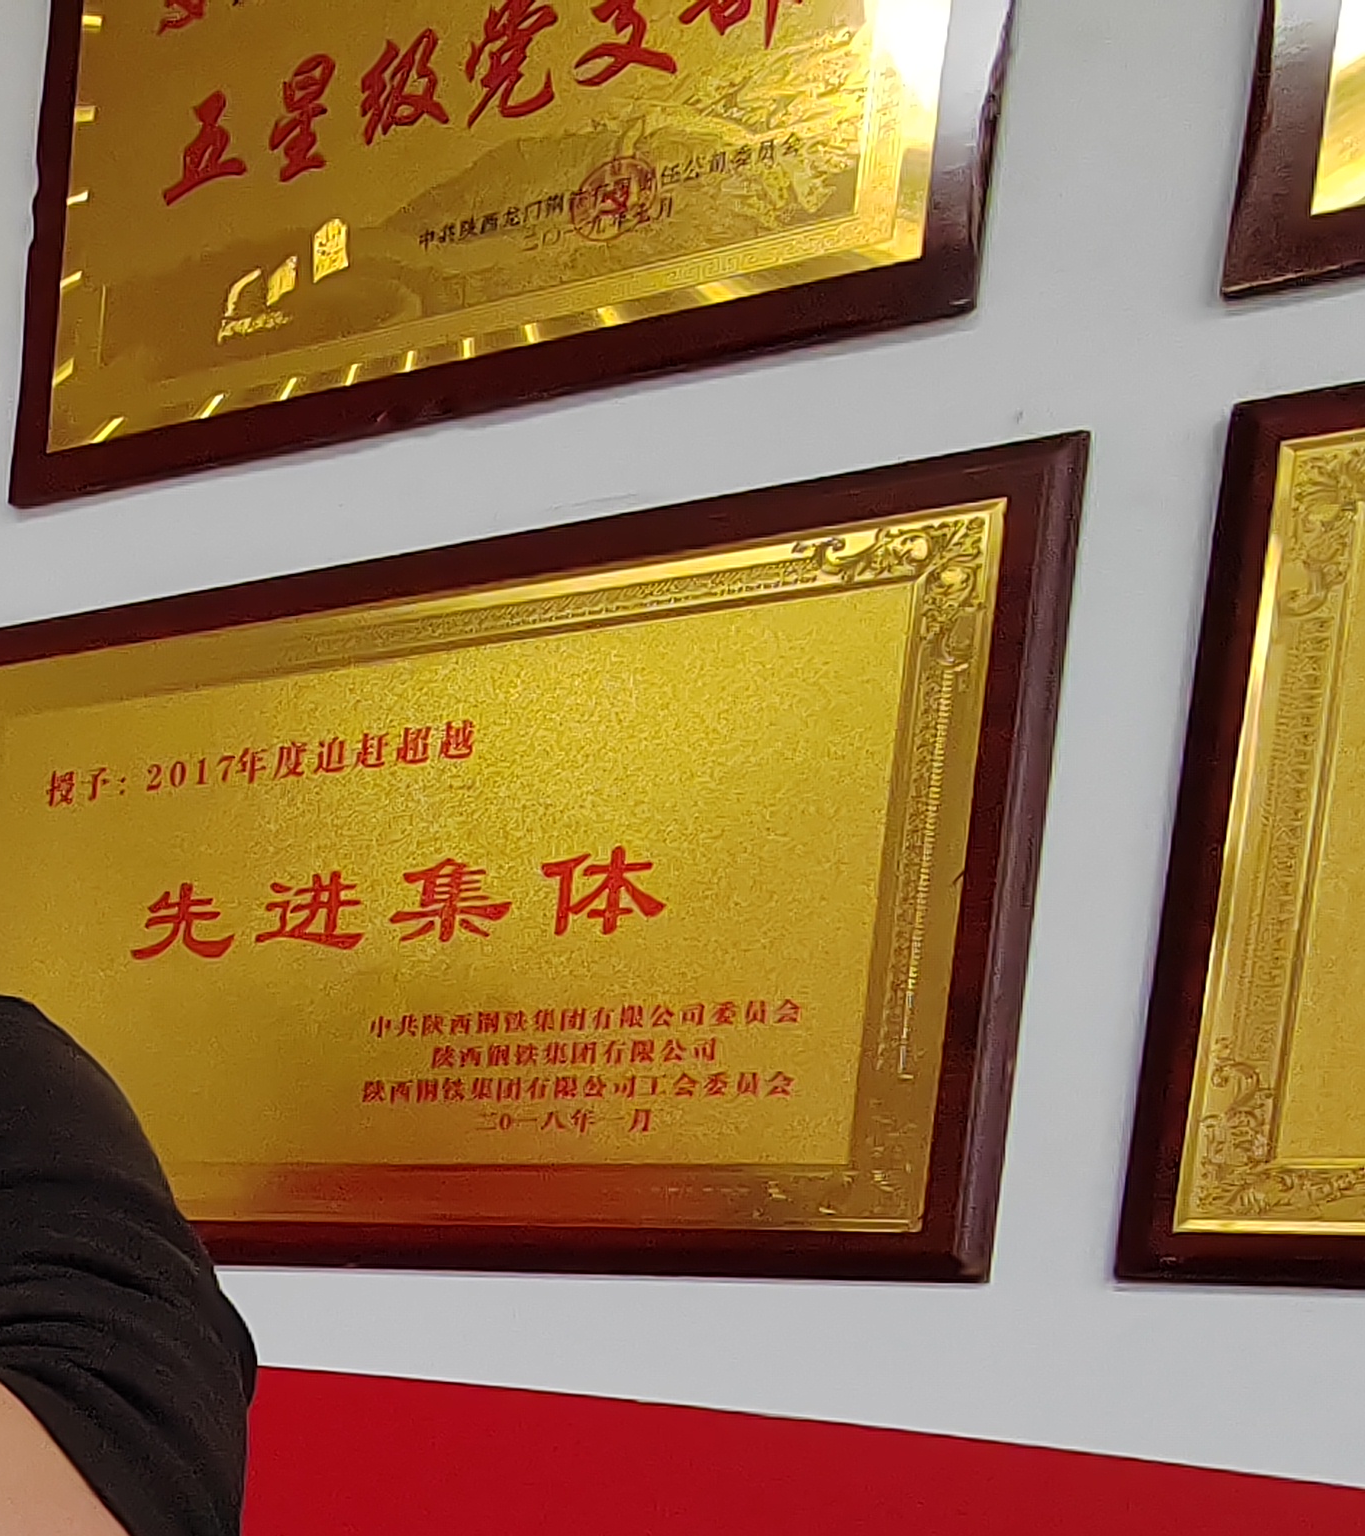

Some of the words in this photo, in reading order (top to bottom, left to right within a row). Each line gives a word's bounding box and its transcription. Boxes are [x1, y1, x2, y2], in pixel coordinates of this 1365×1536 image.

[131, 845, 670, 962] 先进集体
[431, 1037, 717, 1070] 陕西钢铁集团有限公司
